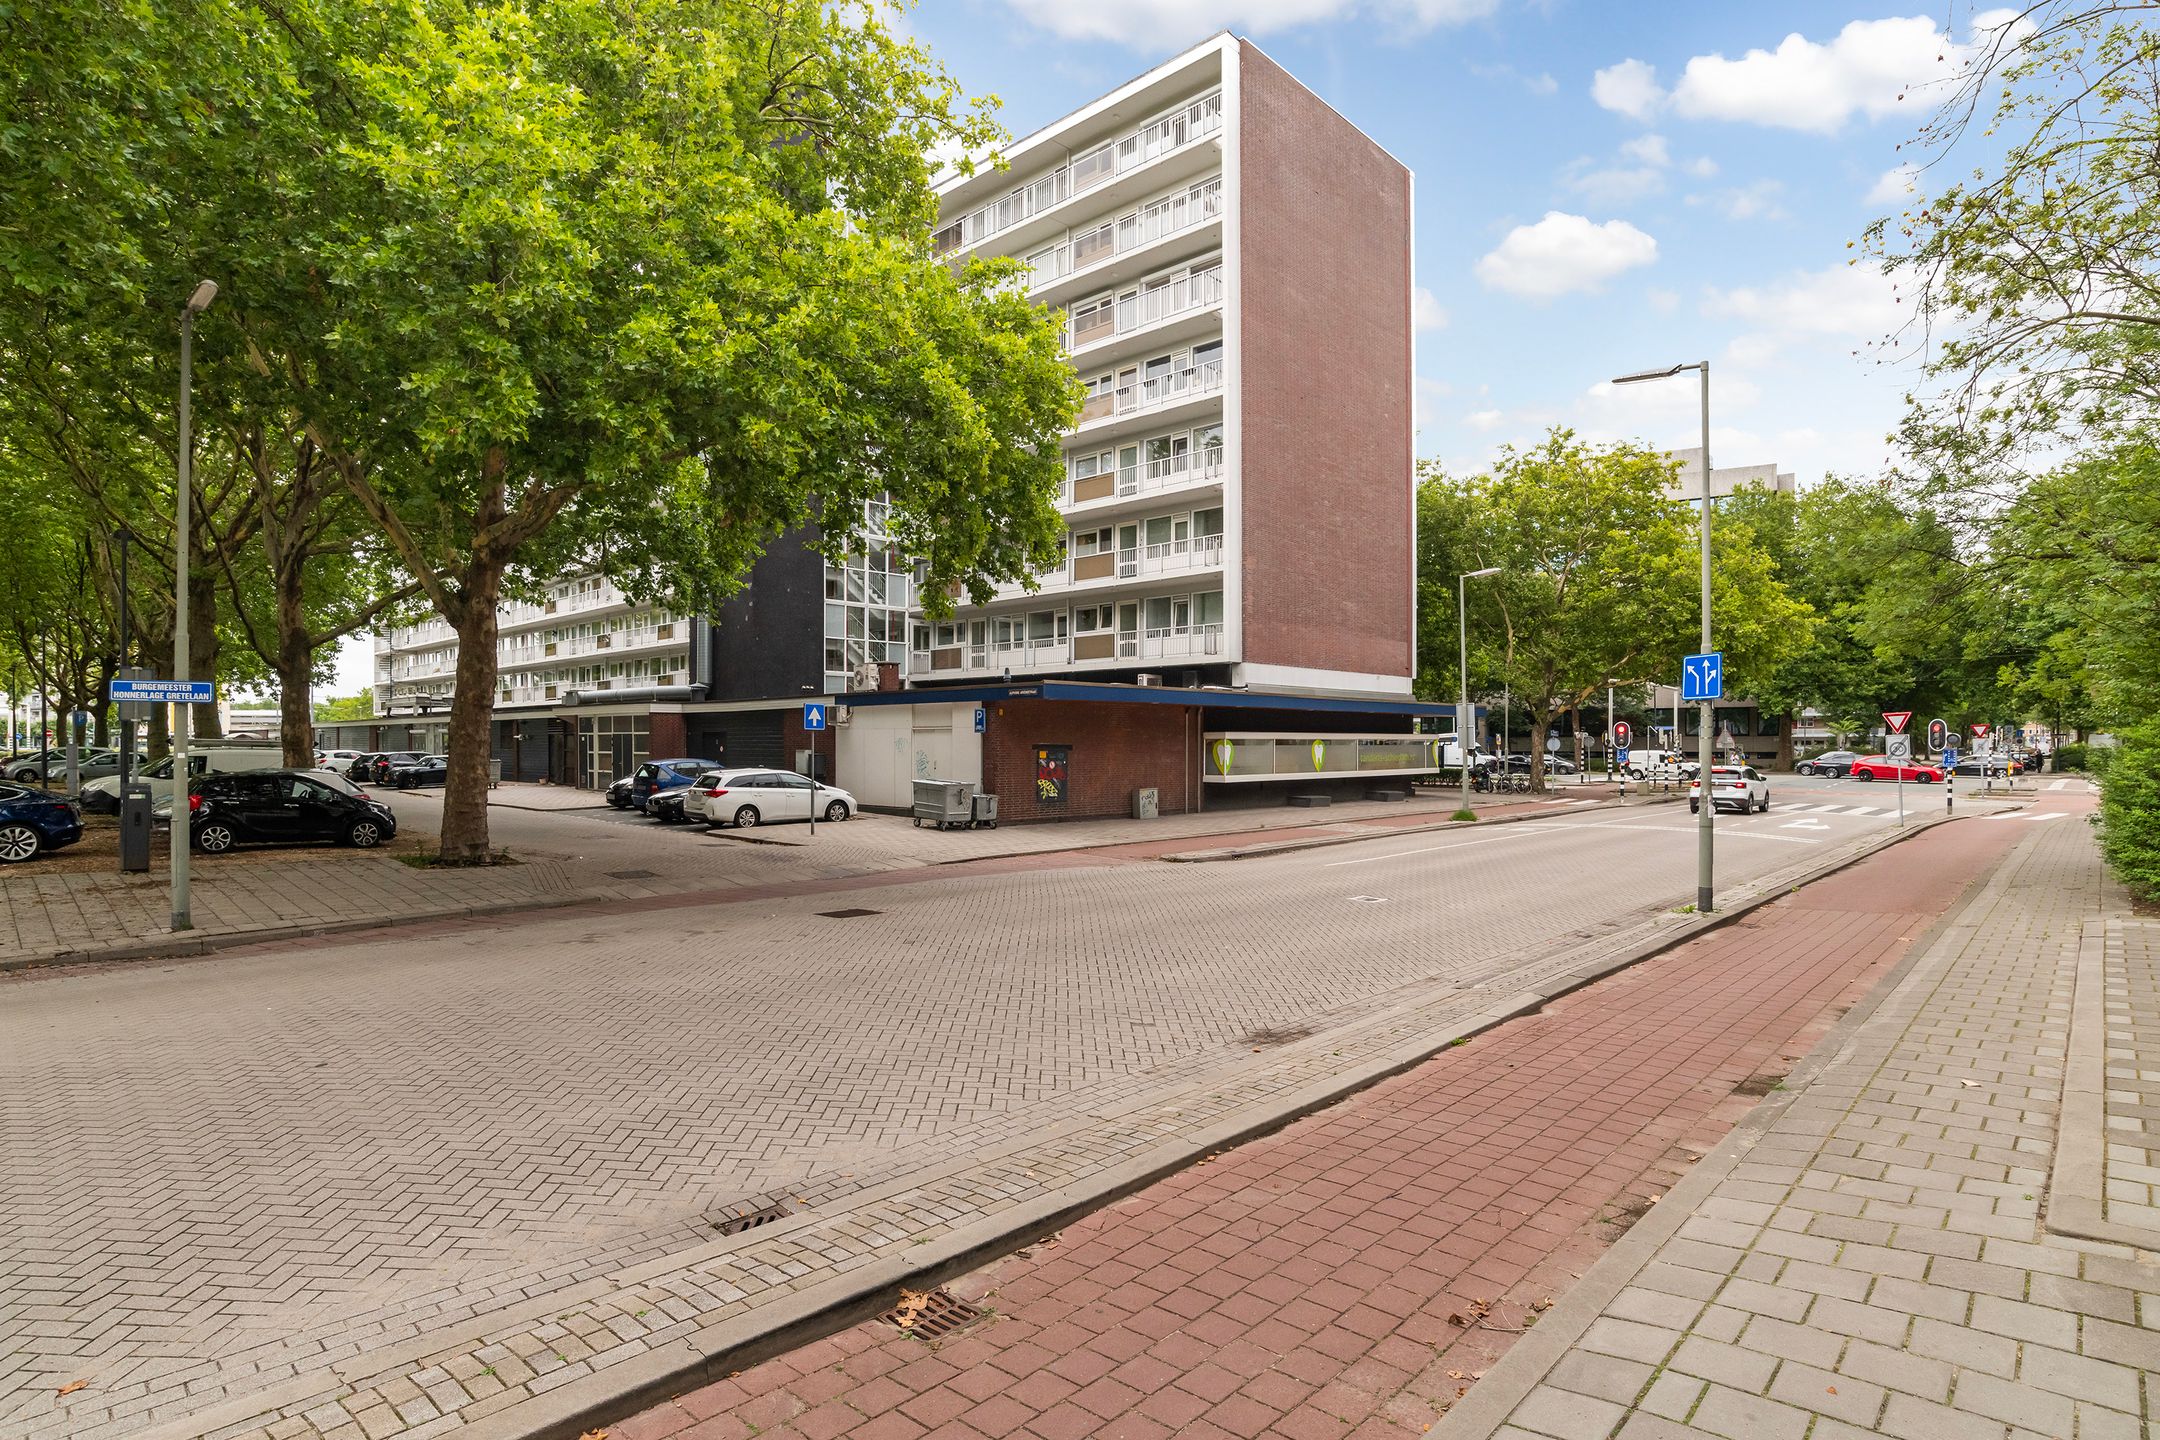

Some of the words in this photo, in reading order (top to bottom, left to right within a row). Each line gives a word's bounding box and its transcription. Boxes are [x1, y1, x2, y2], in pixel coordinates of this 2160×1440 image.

[132, 683, 192, 692] BURGEMEESTER
[113, 691, 164, 700] HONNERLAGE
[166, 692, 209, 700] GRETELAAN
[976, 710, 982, 722] P
